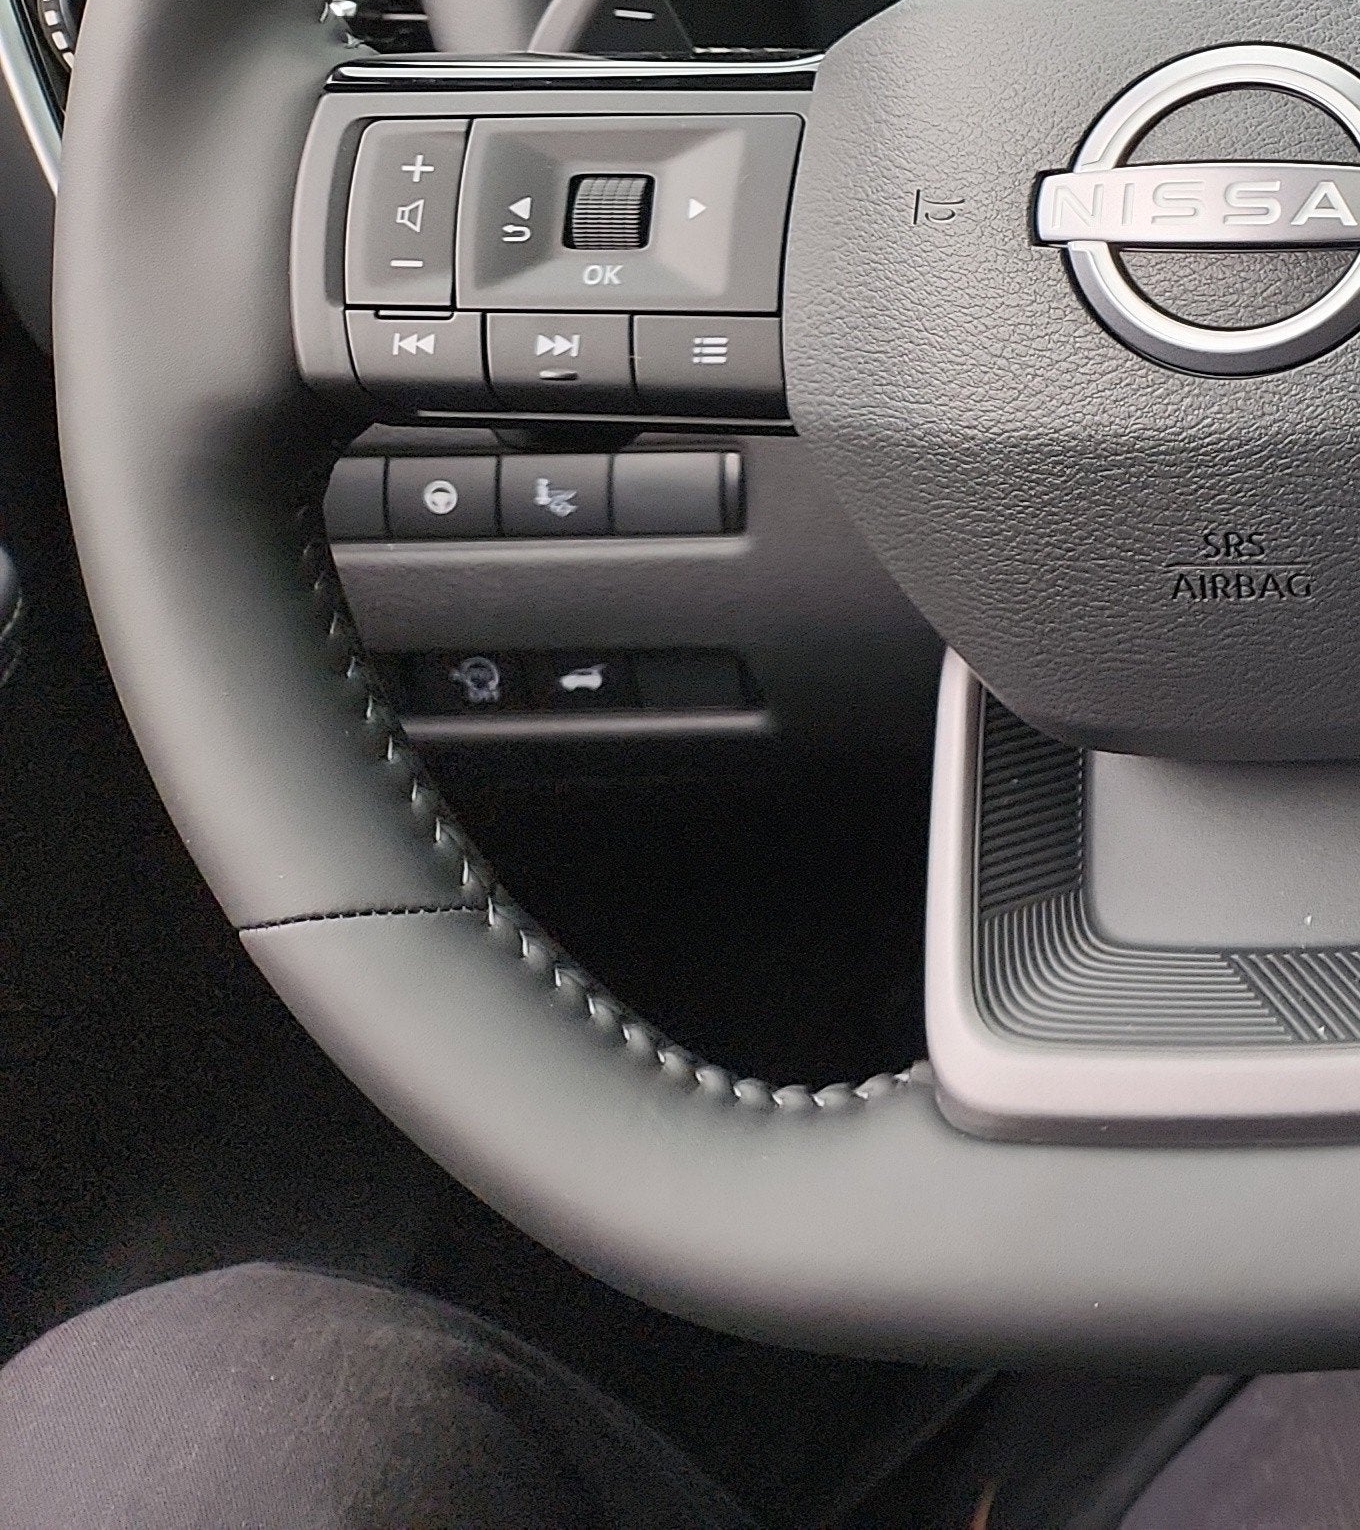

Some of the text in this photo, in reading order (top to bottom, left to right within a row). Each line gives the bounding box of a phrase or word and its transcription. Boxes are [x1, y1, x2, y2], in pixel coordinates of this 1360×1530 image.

[583, 265, 622, 287] OK
[1203, 532, 1264, 560] SRS
[1171, 572, 1313, 600] AIRBAG
